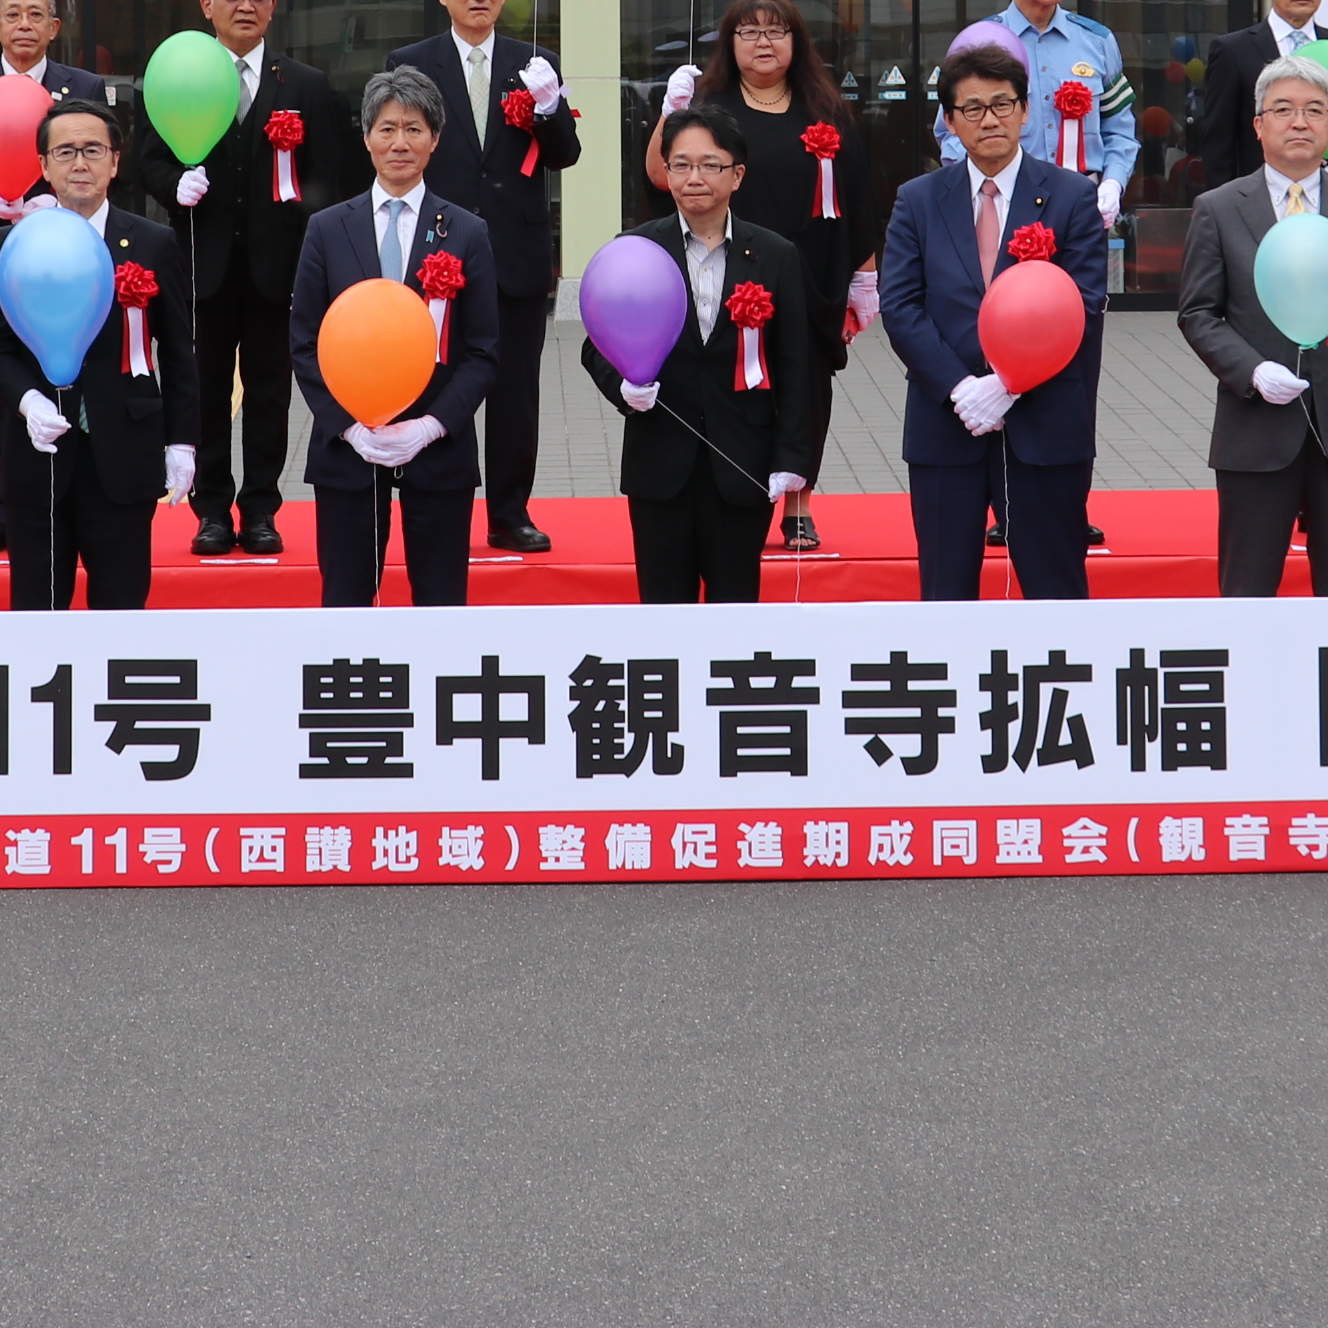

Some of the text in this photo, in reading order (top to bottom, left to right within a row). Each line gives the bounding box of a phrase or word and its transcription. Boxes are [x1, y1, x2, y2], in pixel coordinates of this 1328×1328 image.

[298, 647, 1230, 782] 豊中観音寺拡幅
